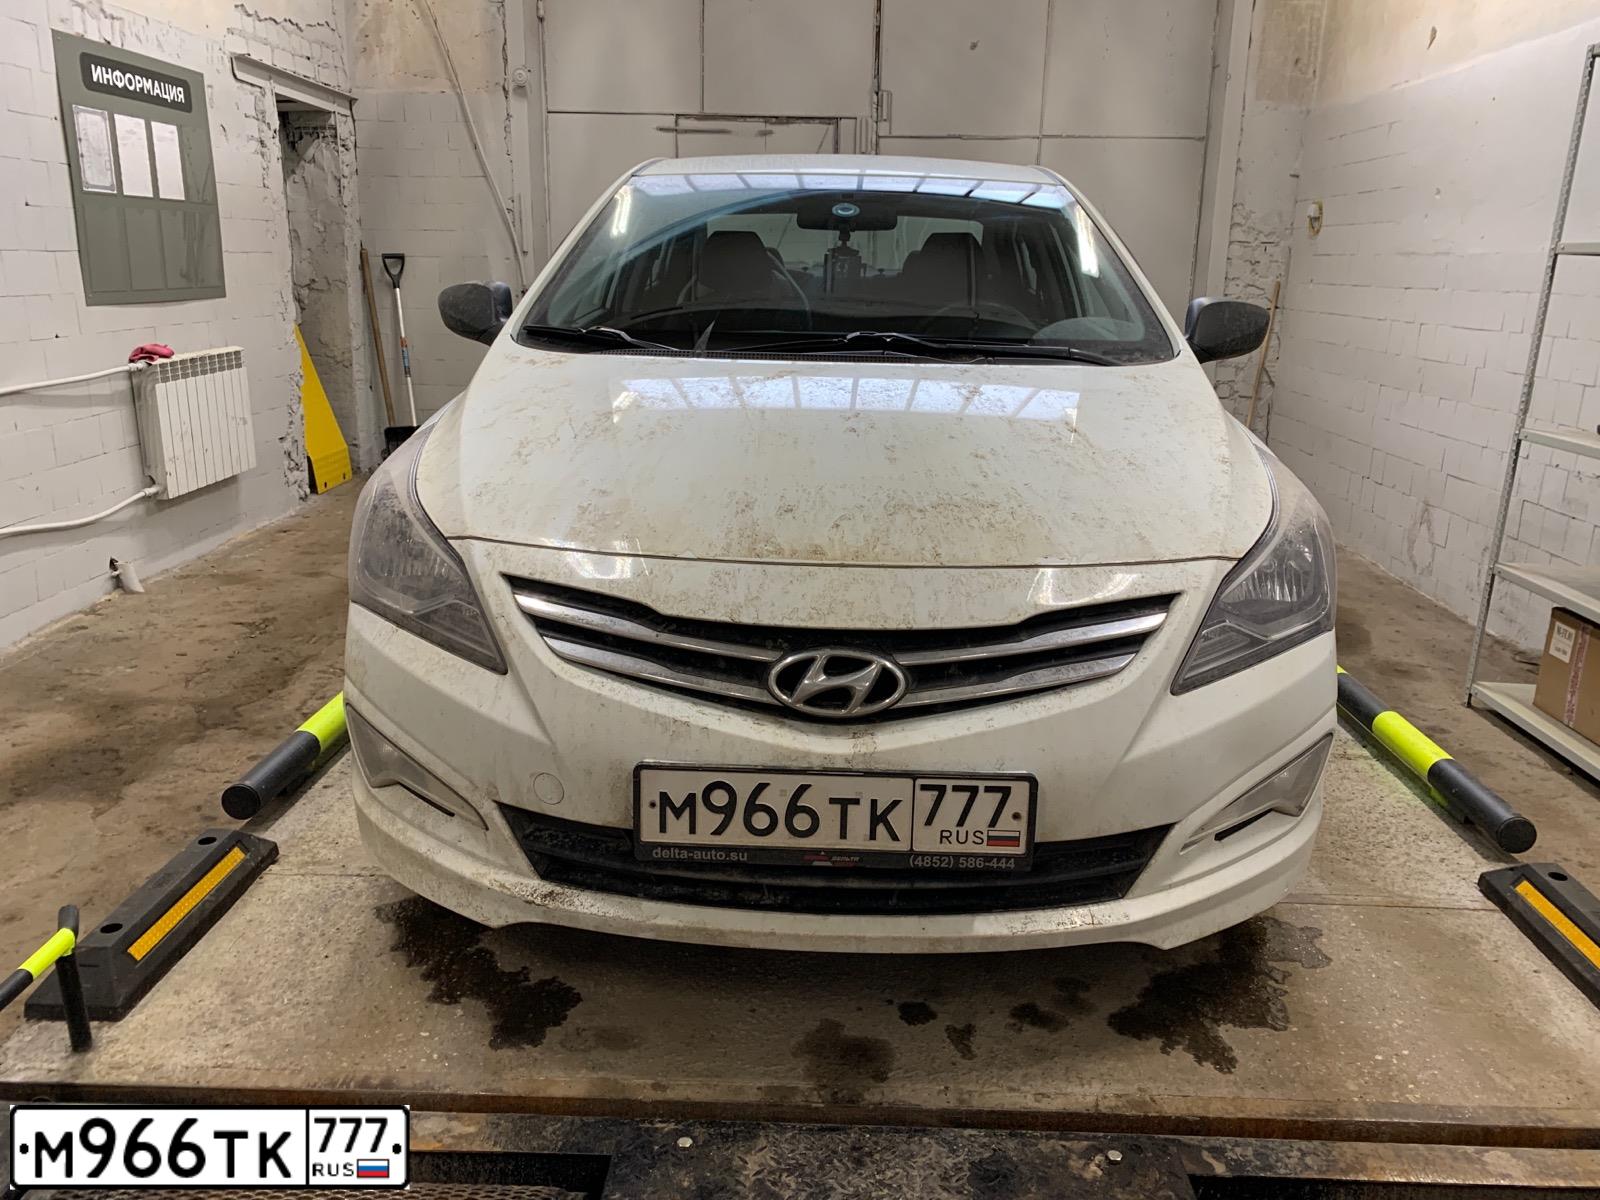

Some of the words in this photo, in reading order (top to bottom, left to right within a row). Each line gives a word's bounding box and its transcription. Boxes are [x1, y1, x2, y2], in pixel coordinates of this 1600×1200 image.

[90, 64, 185, 103] ИНФОРМАЦИЯ
[658, 780, 904, 842] М966ТК
[919, 783, 1012, 829] 777
[939, 829, 985, 846] RUS
[652, 847, 748, 861] delta-auto.su
[909, 854, 954, 869] (4852)
[958, 856, 1016, 870] 586-444
